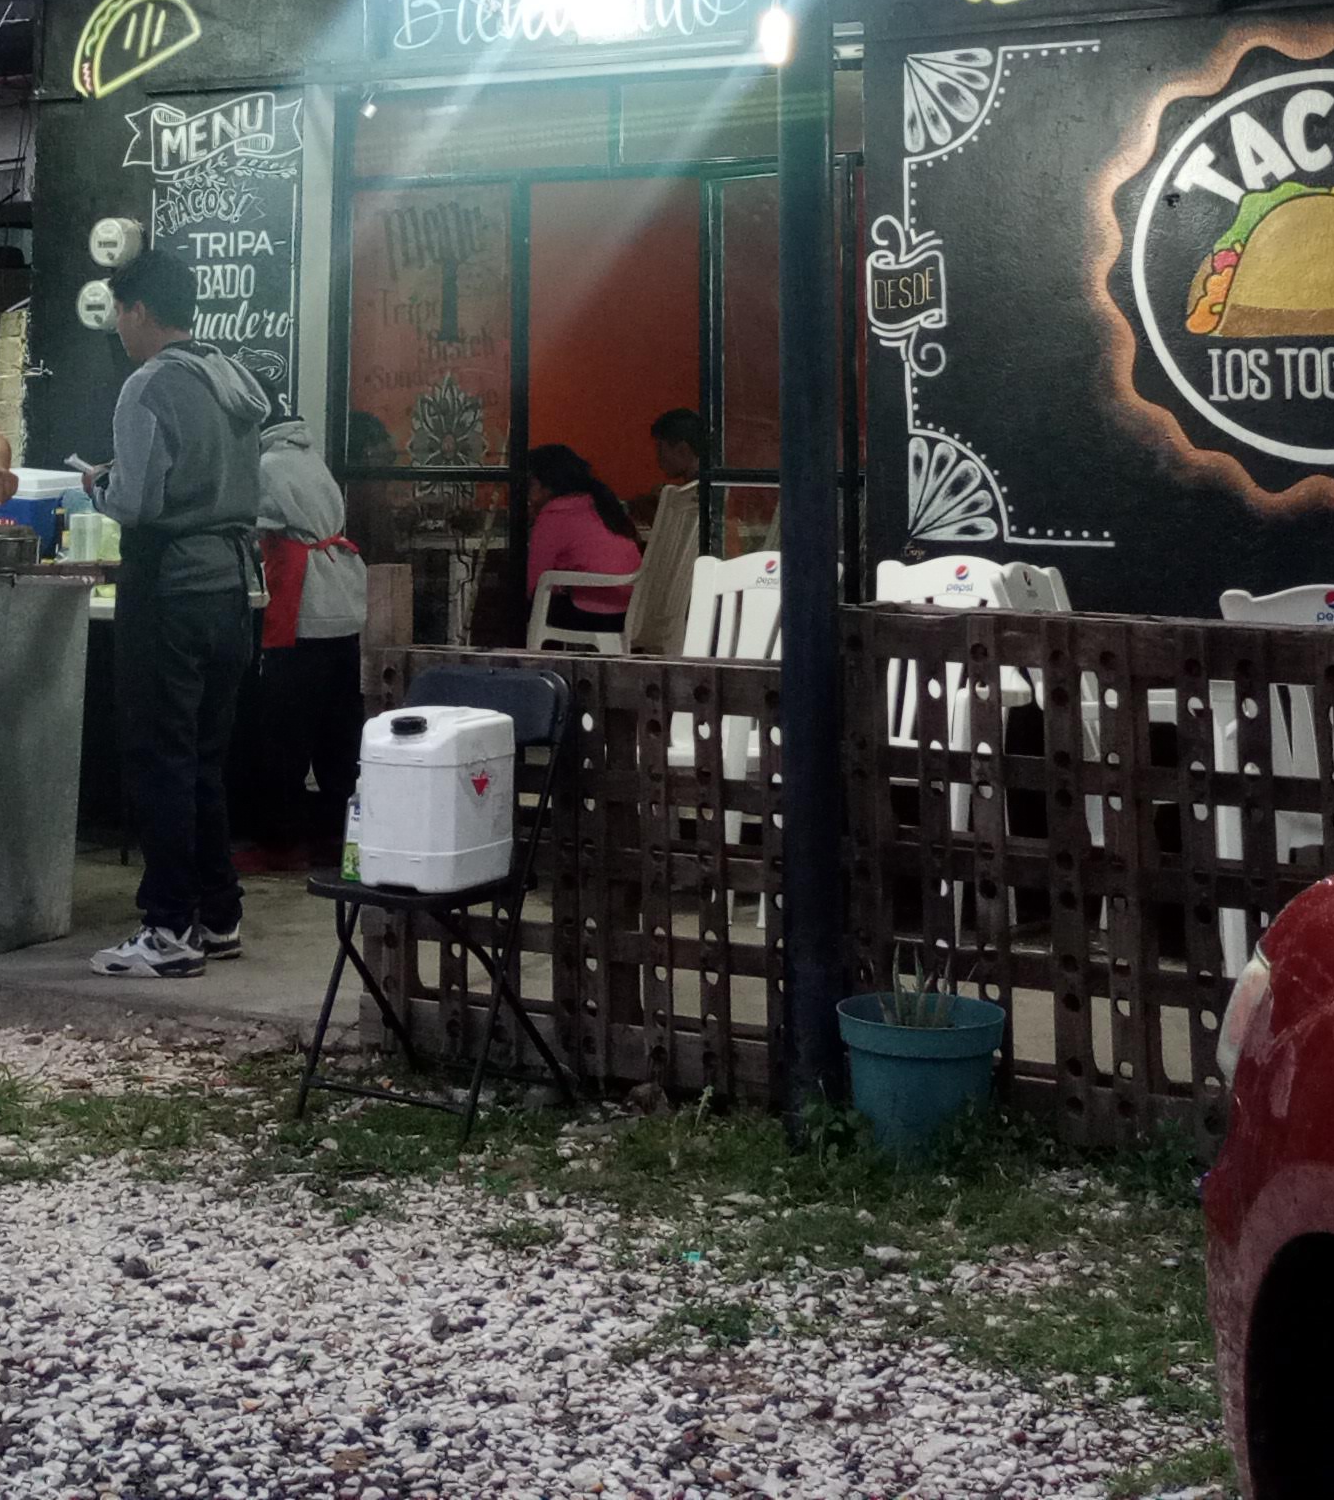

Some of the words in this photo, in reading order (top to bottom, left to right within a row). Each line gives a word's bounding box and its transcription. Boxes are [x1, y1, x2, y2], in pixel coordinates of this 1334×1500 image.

[161, 97, 265, 168] MENU
[191, 263, 256, 300] BADO
[873, 265, 937, 311] DESDE
[1206, 347, 1272, 402] LOS
[945, 582, 974, 594] pepsi
